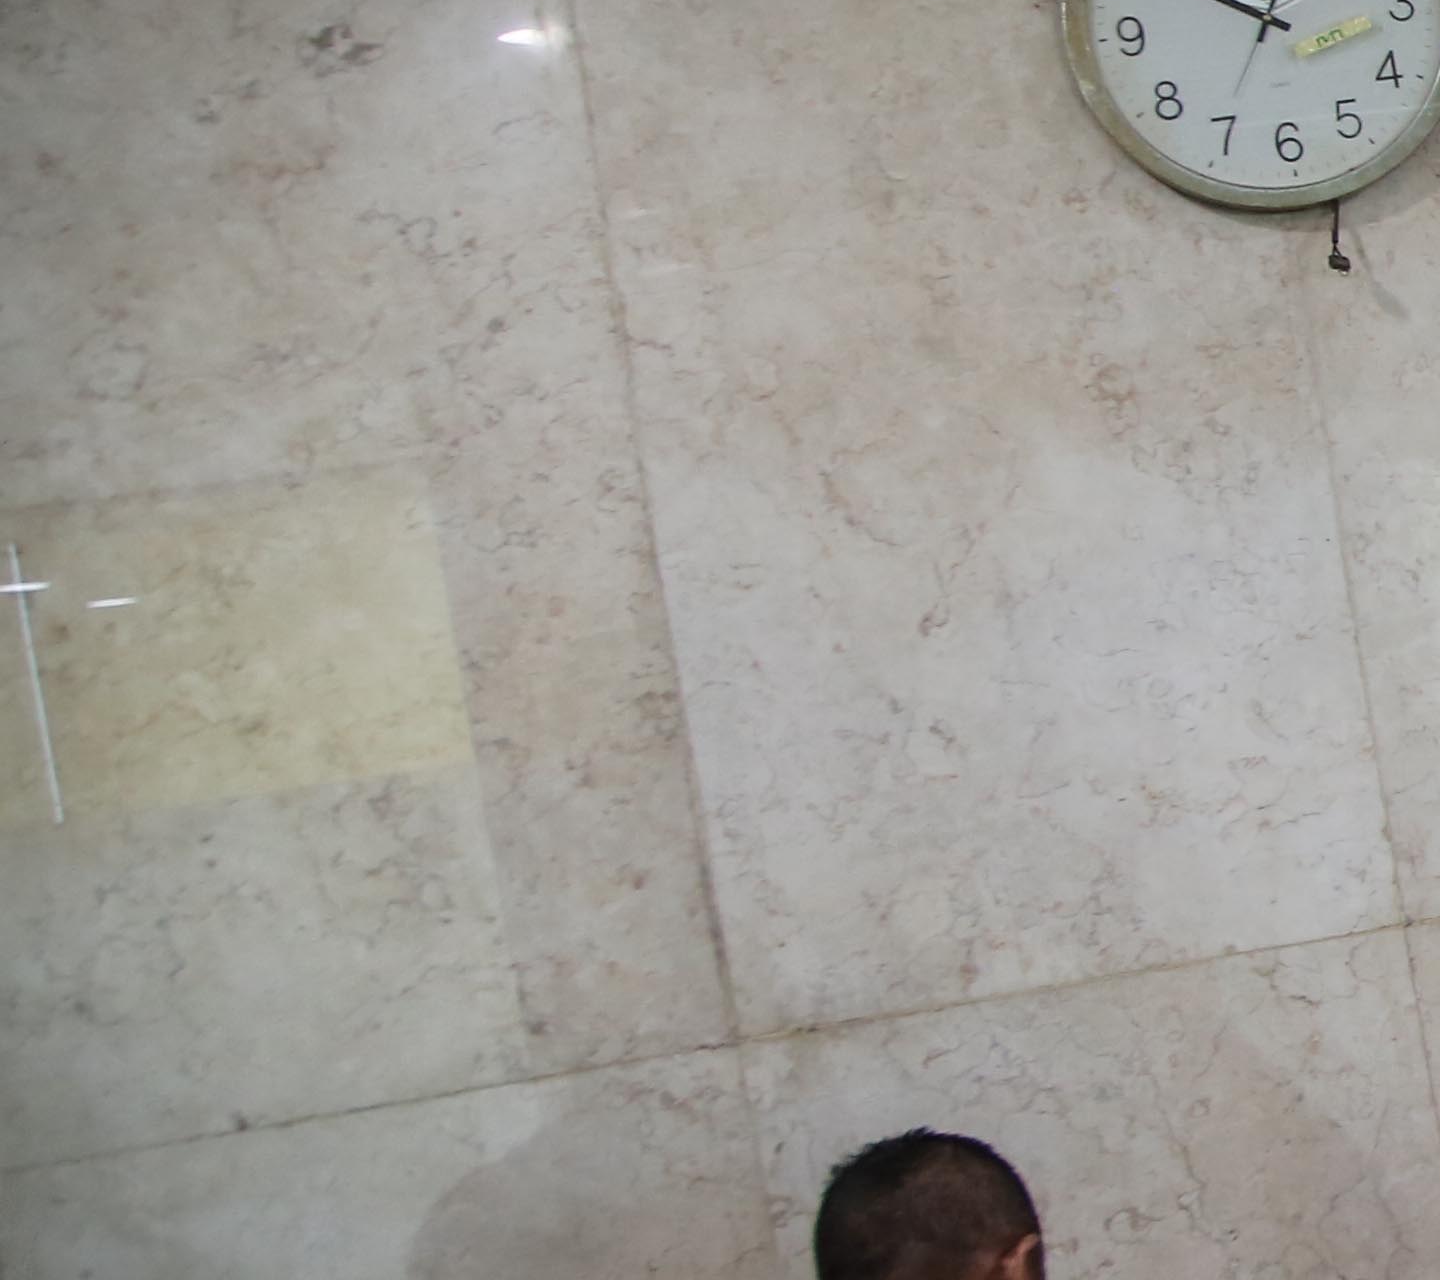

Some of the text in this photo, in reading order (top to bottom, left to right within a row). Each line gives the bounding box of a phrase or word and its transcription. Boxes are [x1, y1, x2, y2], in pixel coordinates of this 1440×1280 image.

[1116, 16, 1145, 56] 9
[1375, 50, 1403, 88] 4
[1155, 80, 1184, 120] 8
[1335, 98, 1362, 138] 5
[1211, 116, 1236, 155] 7
[1274, 122, 1304, 162] 6
